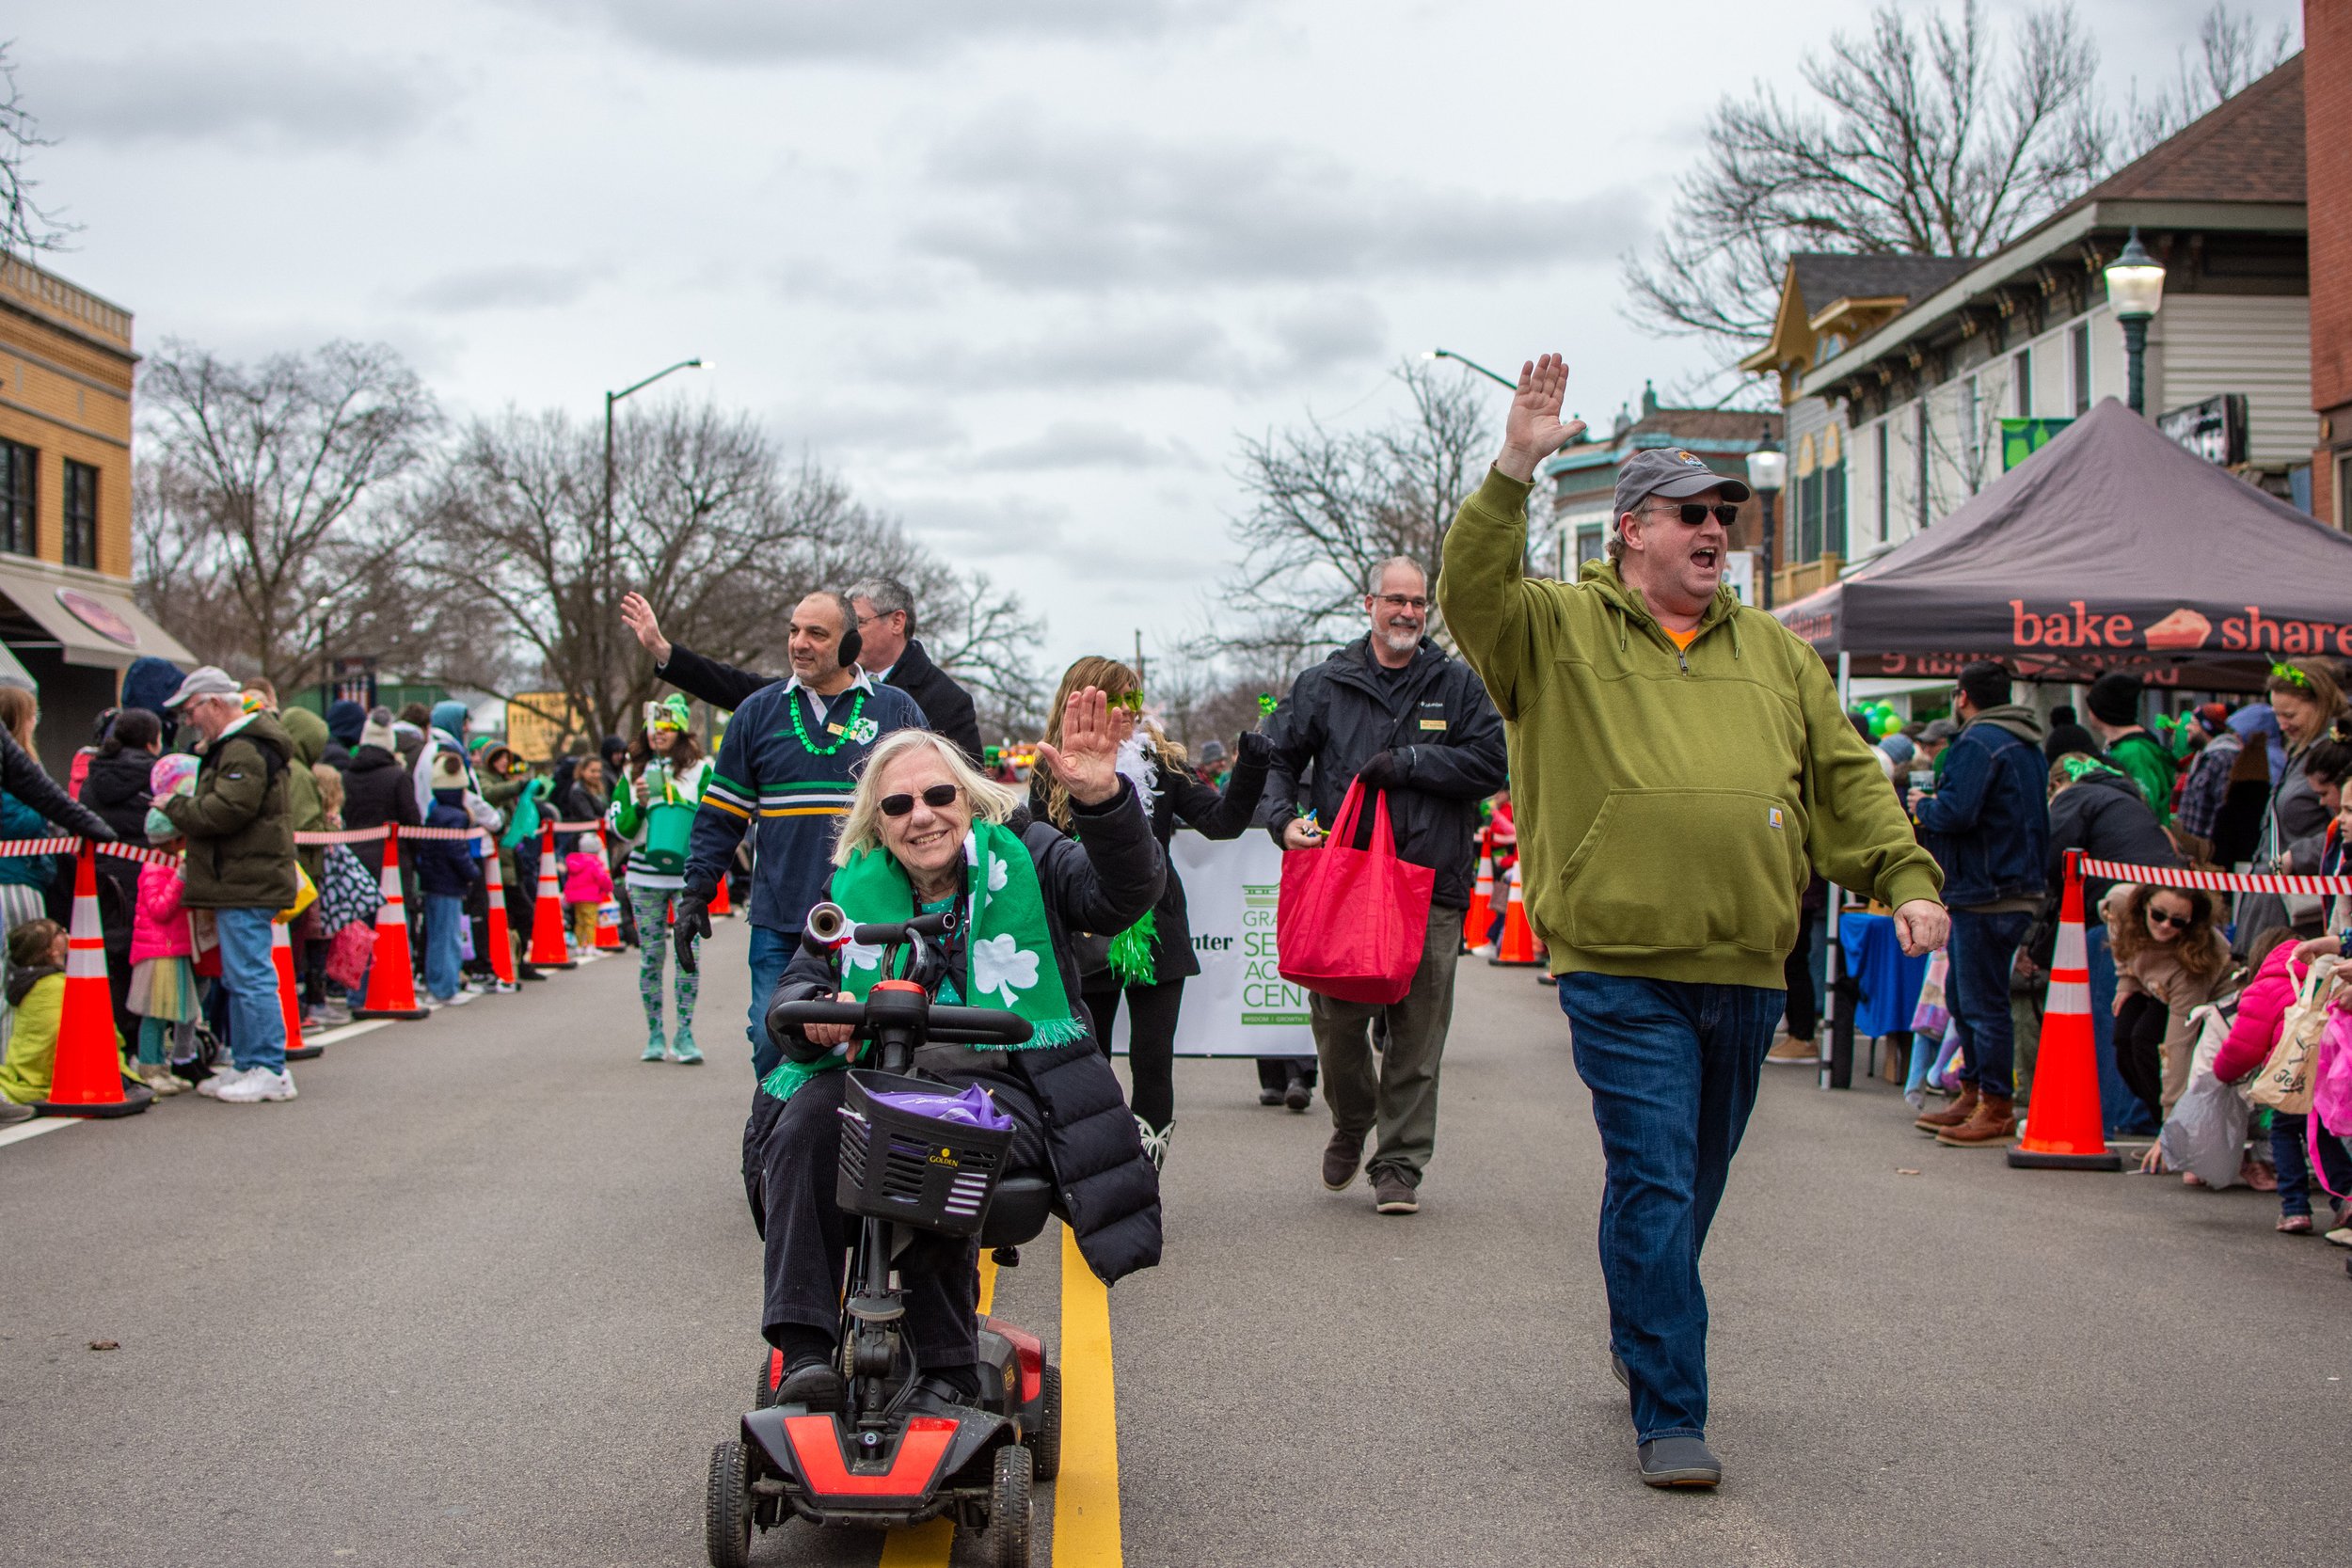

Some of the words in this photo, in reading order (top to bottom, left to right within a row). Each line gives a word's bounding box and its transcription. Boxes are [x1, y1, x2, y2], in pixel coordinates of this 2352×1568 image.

[2009, 599, 2134, 647] bake
[2221, 606, 2352, 657] share
[1190, 933, 1233, 951] nter
[1244, 932, 1278, 958] SE
[1244, 960, 1278, 981] AC
[1243, 983, 1302, 1008] CEN
[929, 1155, 959, 1167] GOLDEN
